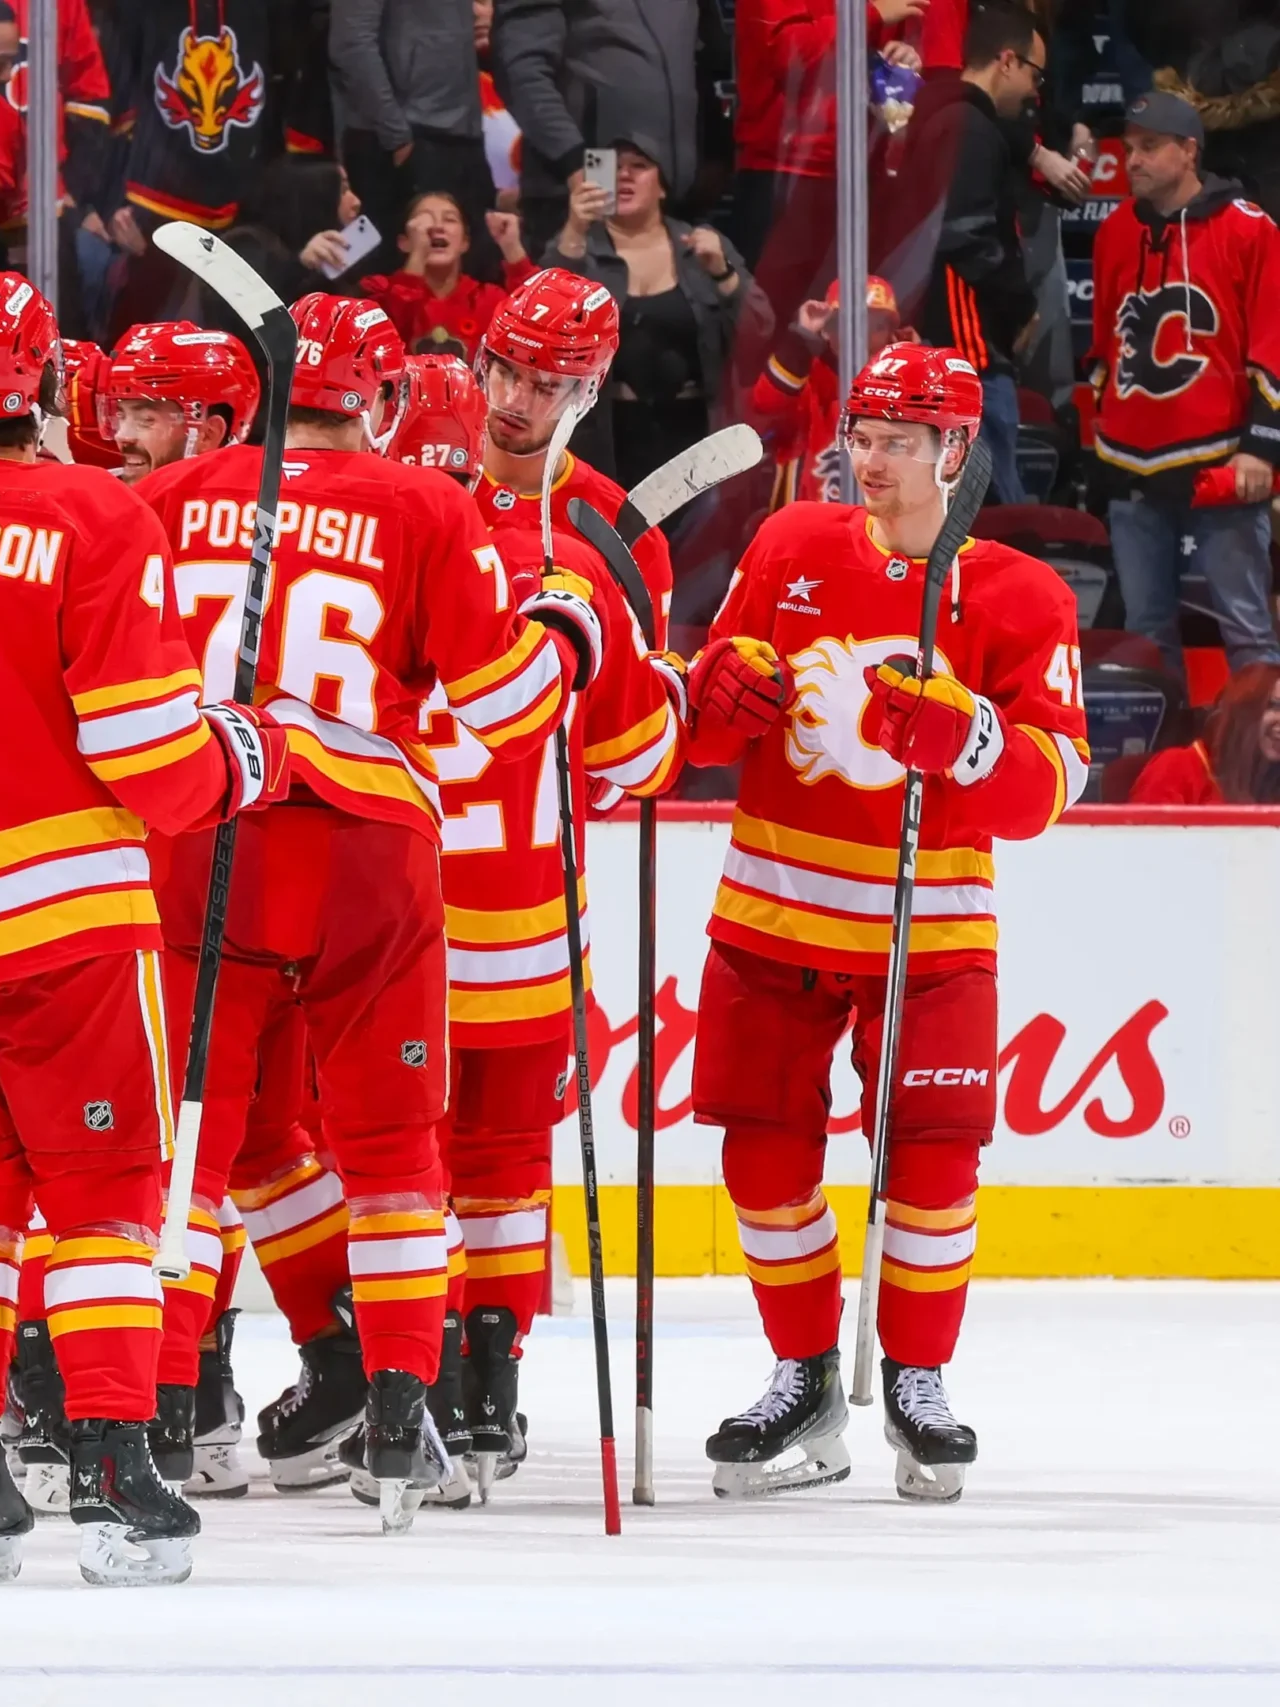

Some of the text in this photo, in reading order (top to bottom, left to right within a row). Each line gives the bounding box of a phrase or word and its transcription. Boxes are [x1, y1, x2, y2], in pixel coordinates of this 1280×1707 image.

[530, 303, 550, 322] 7
[296, 339, 324, 366] 76
[863, 386, 902, 399] CCM
[421, 443, 451, 467] 27
[179, 499, 386, 571] POSPISIL
[172, 558, 387, 730] 76
[903, 1068, 990, 1087] CCM
